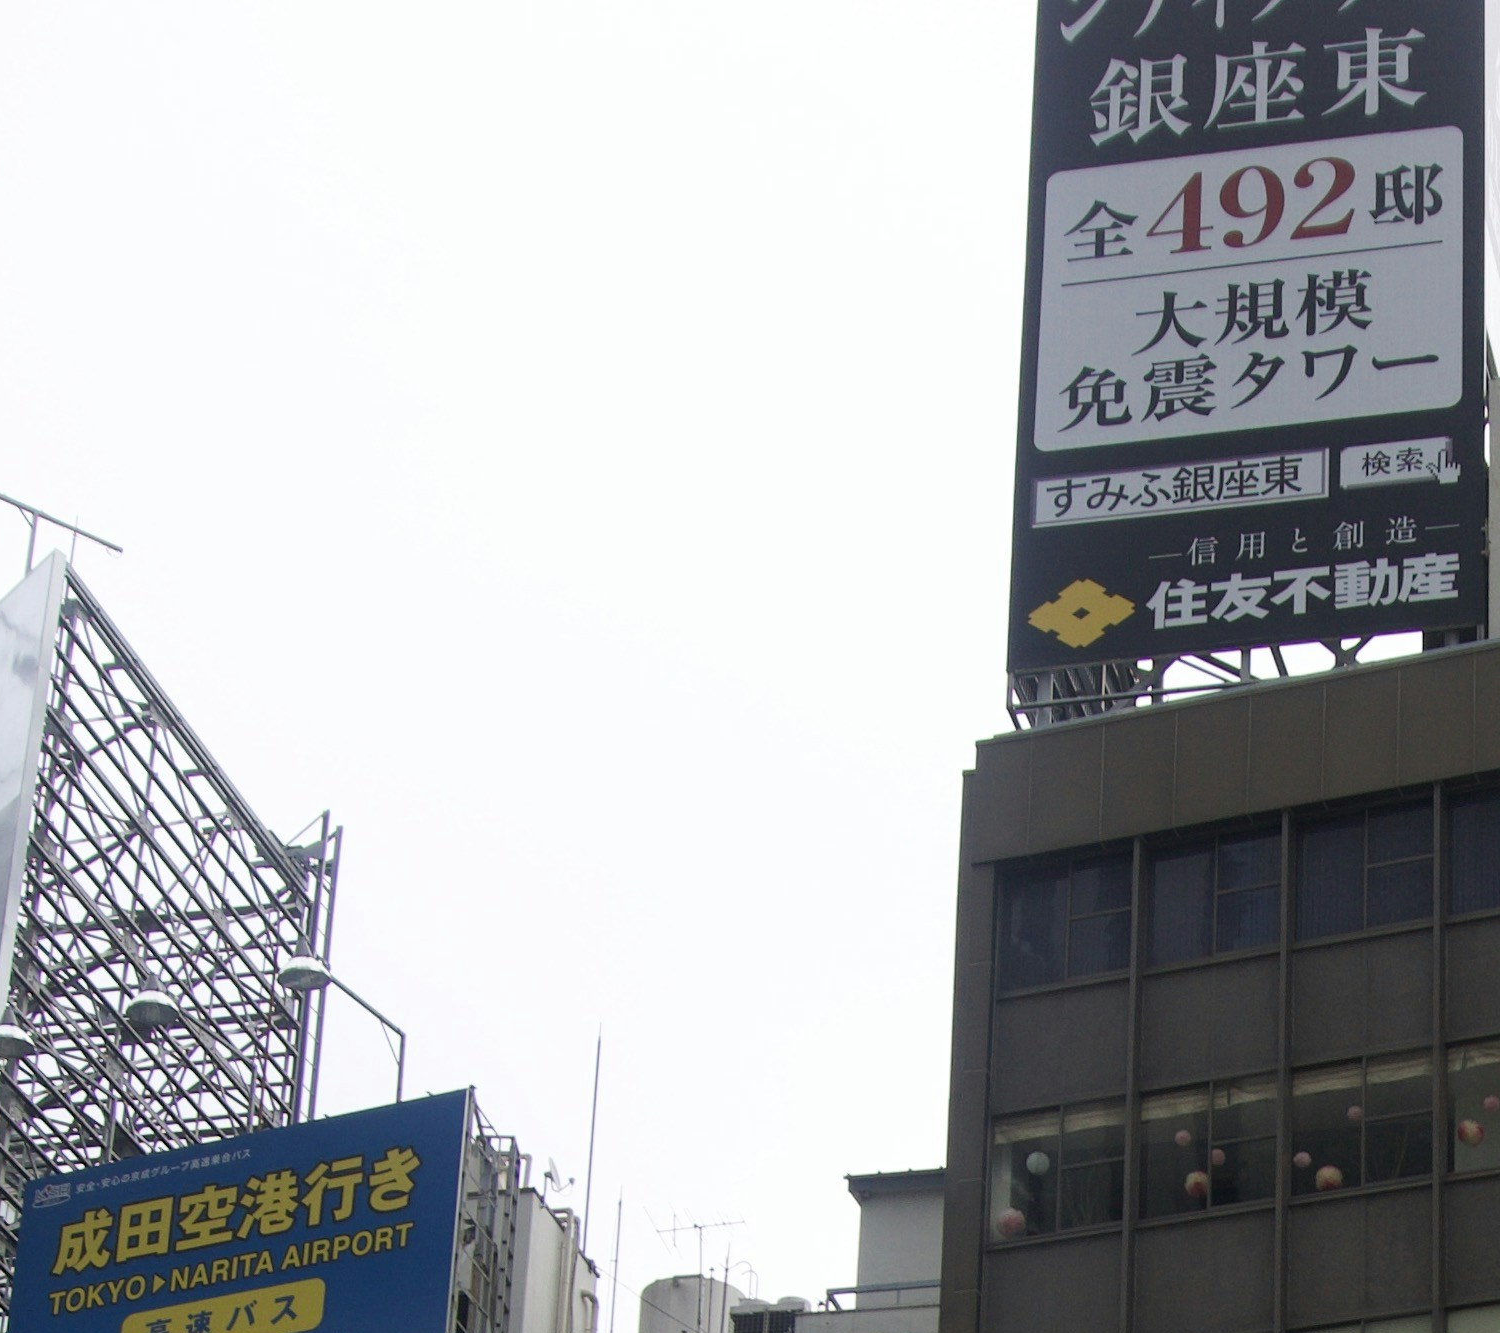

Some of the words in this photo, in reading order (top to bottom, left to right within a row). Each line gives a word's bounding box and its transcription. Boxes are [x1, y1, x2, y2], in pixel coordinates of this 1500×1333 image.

[1089, 28, 1428, 147] 銀座東
[1063, 156, 1444, 262] 全492邸
[1131, 268, 1373, 357] 大規模
[1058, 344, 1440, 432] 免震タワー
[1046, 456, 1303, 517] すみふ銀座東
[1361, 447, 1424, 477] 検索
[1187, 516, 1418, 566] 信用と創造
[1146, 552, 1460, 629] 住友不動産
[52, 1146, 422, 1276] 成田空港行き
[49, 1273, 147, 1315] TOKYO
[168, 1250, 274, 1292] NARITA
[281, 1221, 414, 1271] AIRPORT
